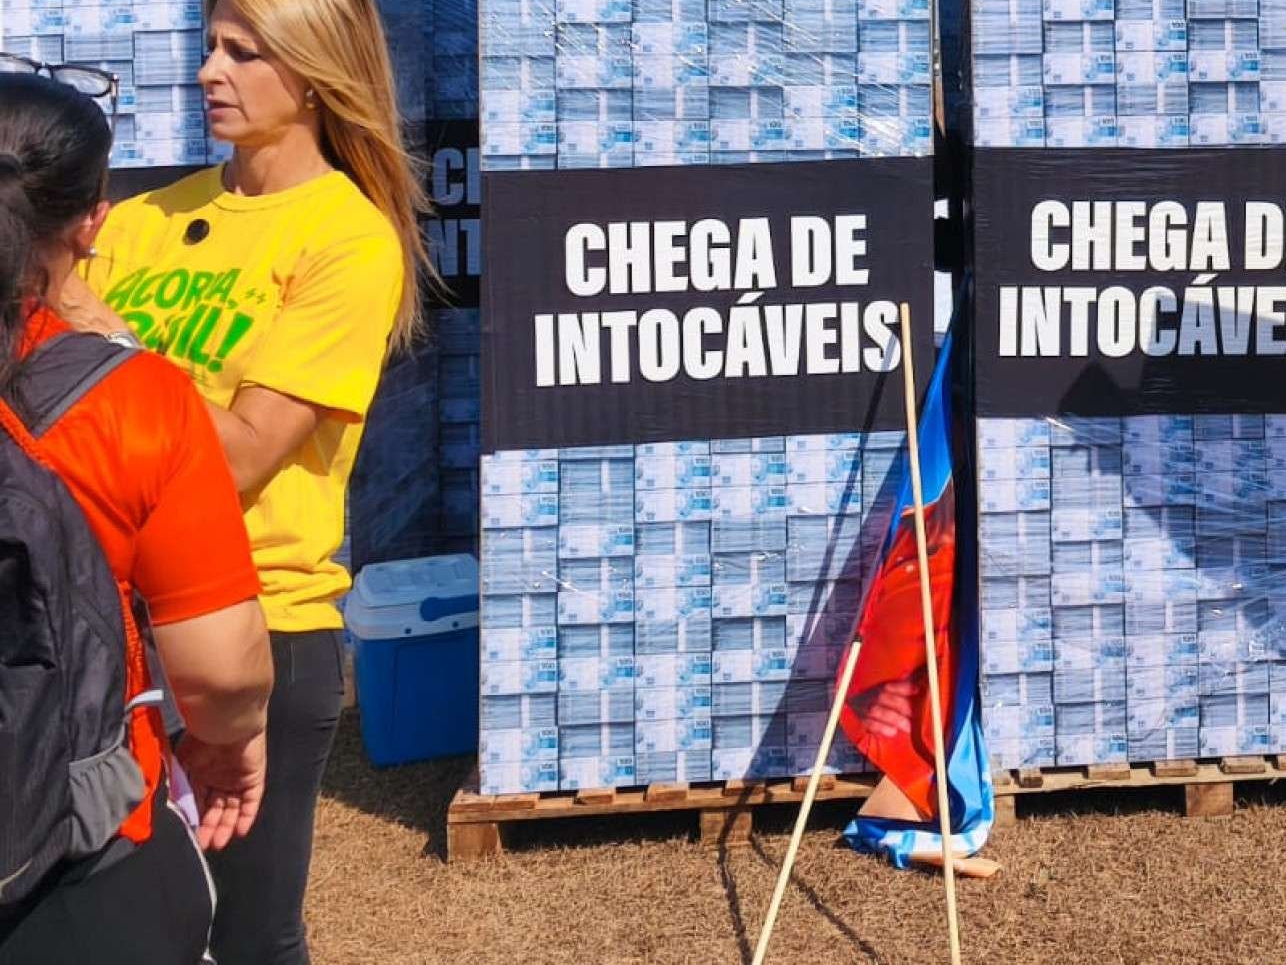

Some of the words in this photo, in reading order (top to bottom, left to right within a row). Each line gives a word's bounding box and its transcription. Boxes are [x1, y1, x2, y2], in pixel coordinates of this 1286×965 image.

[565, 216, 777, 297] CHEGA
[790, 215, 870, 288] DE
[1030, 199, 1231, 272] CHEGA
[534, 292, 901, 387] INTOCÁVEIS
